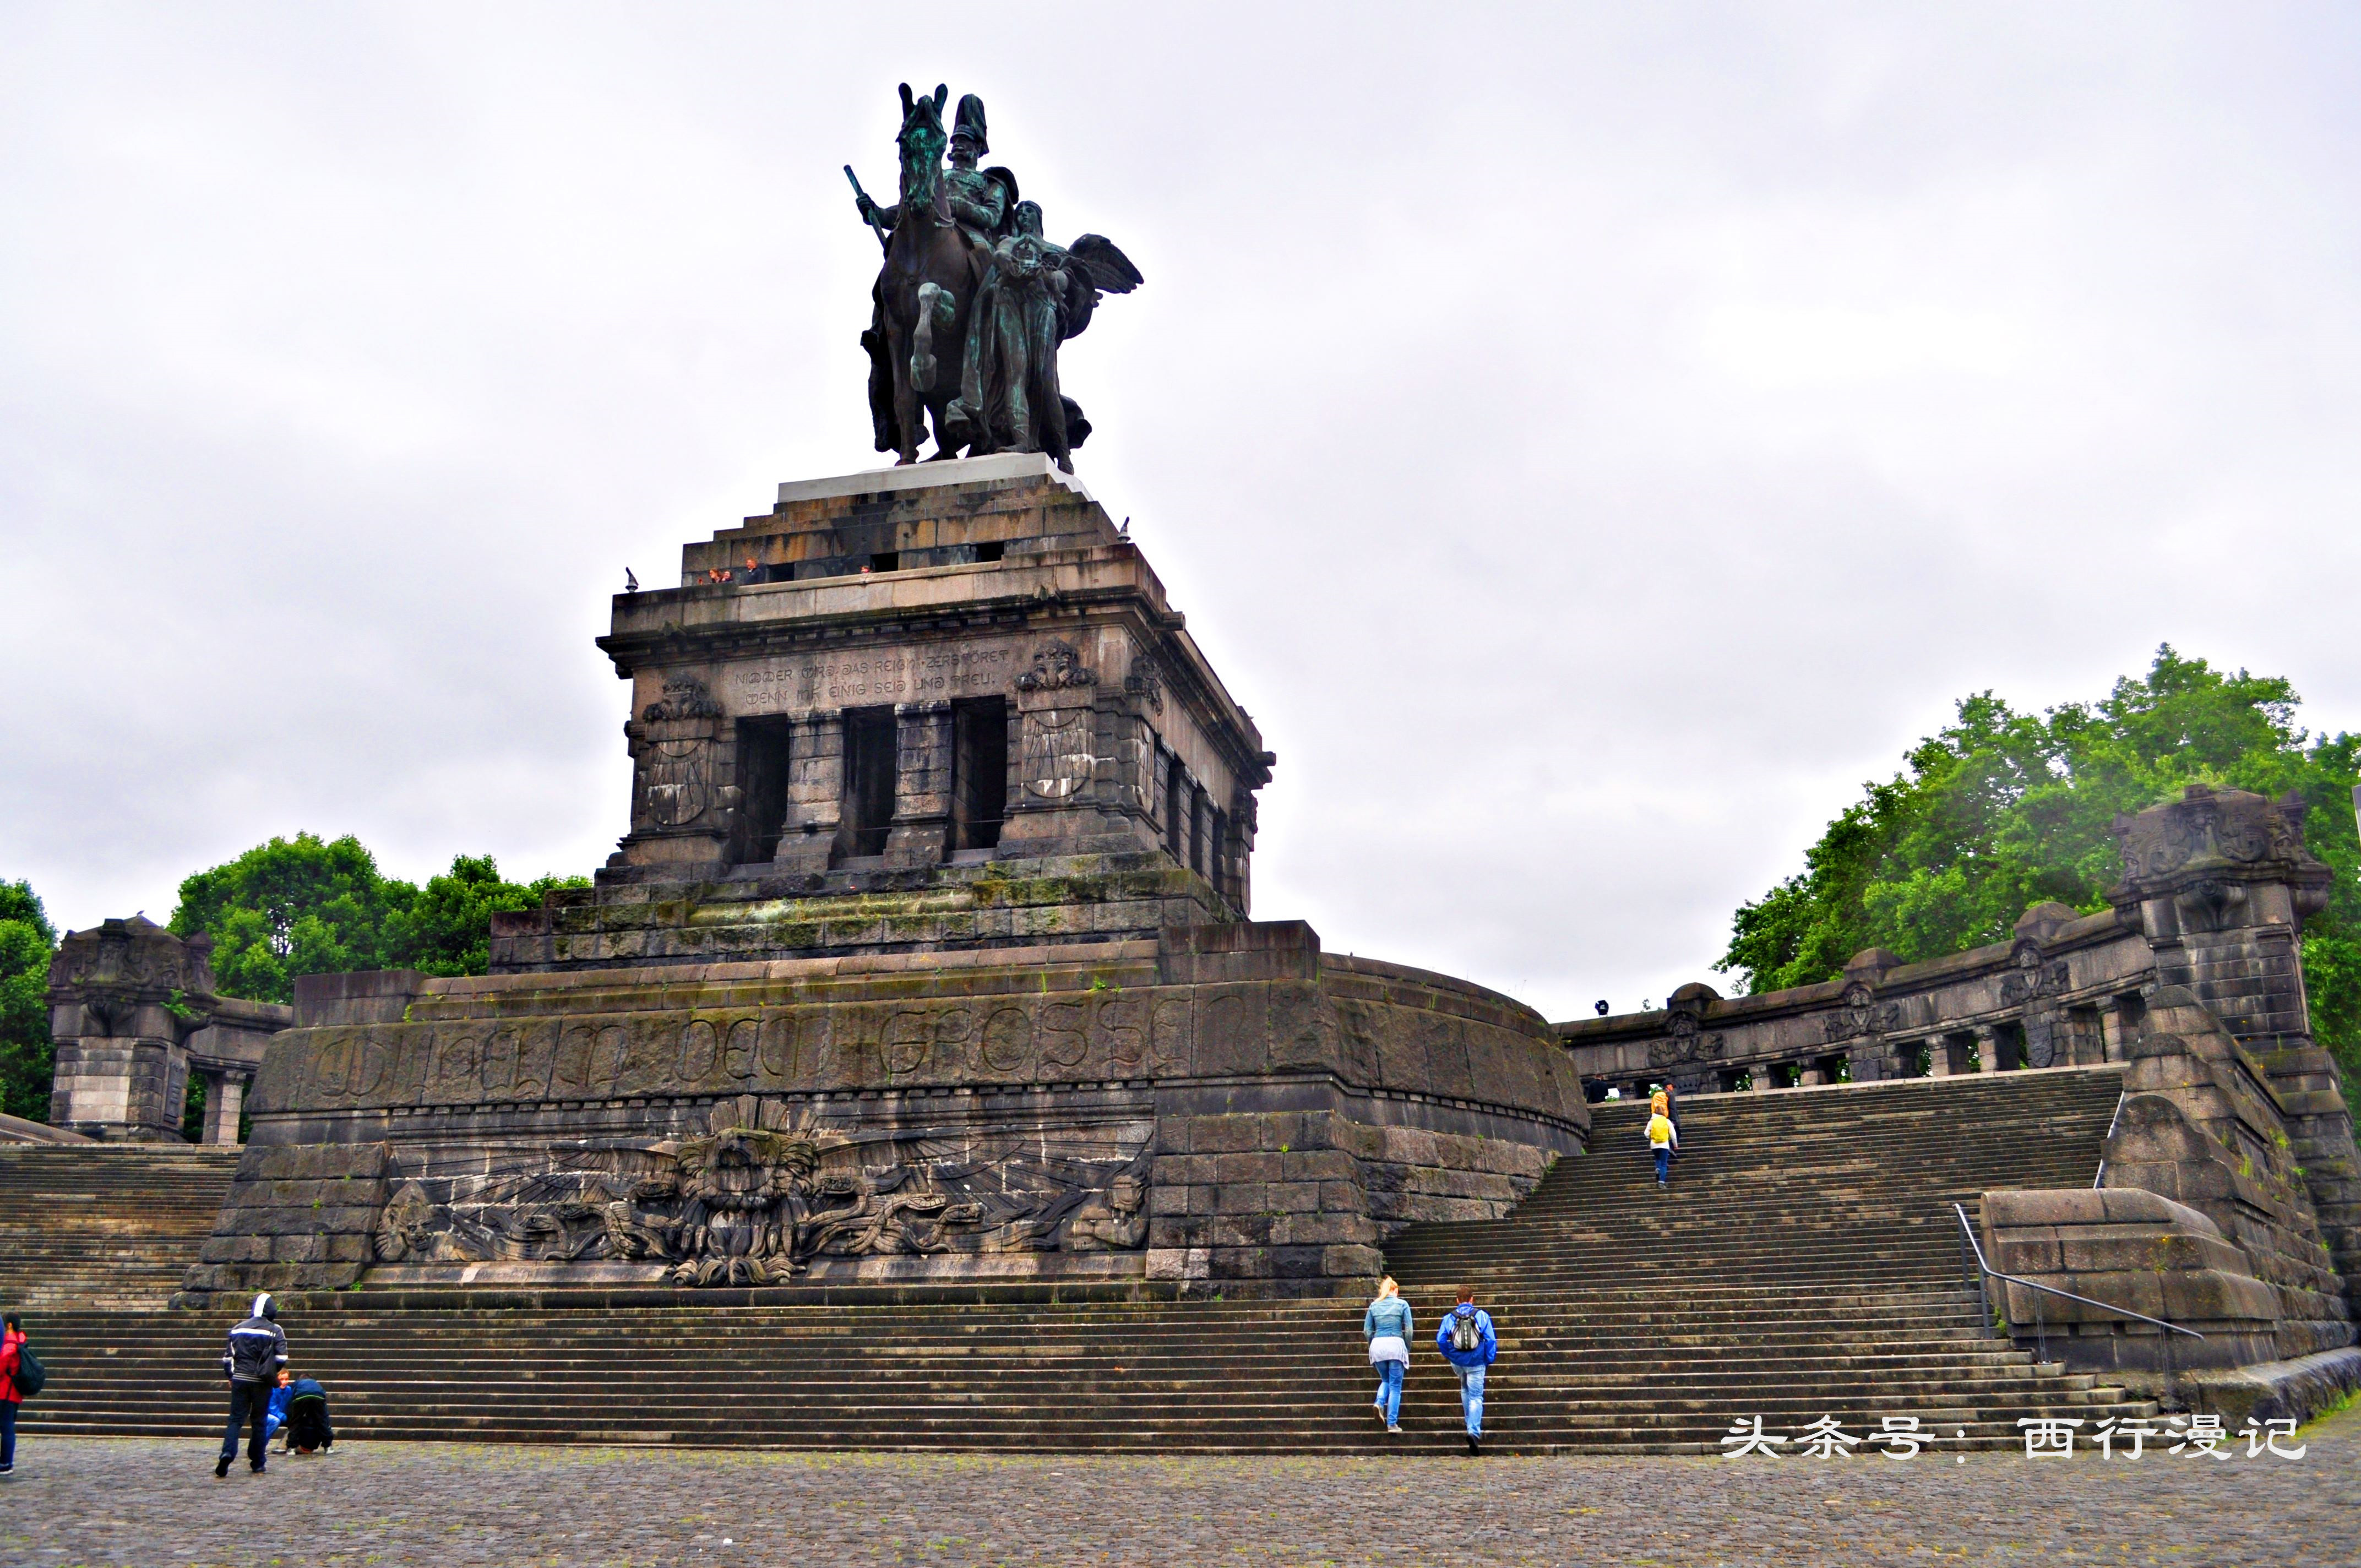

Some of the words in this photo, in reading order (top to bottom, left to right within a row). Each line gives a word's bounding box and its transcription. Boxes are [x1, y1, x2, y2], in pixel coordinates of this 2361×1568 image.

[842, 662, 868, 675] DAS
[746, 690, 787, 705] WENN
[829, 684, 866, 698] EINIG
[874, 680, 906, 694] SEID
[914, 677, 945, 690] UND
